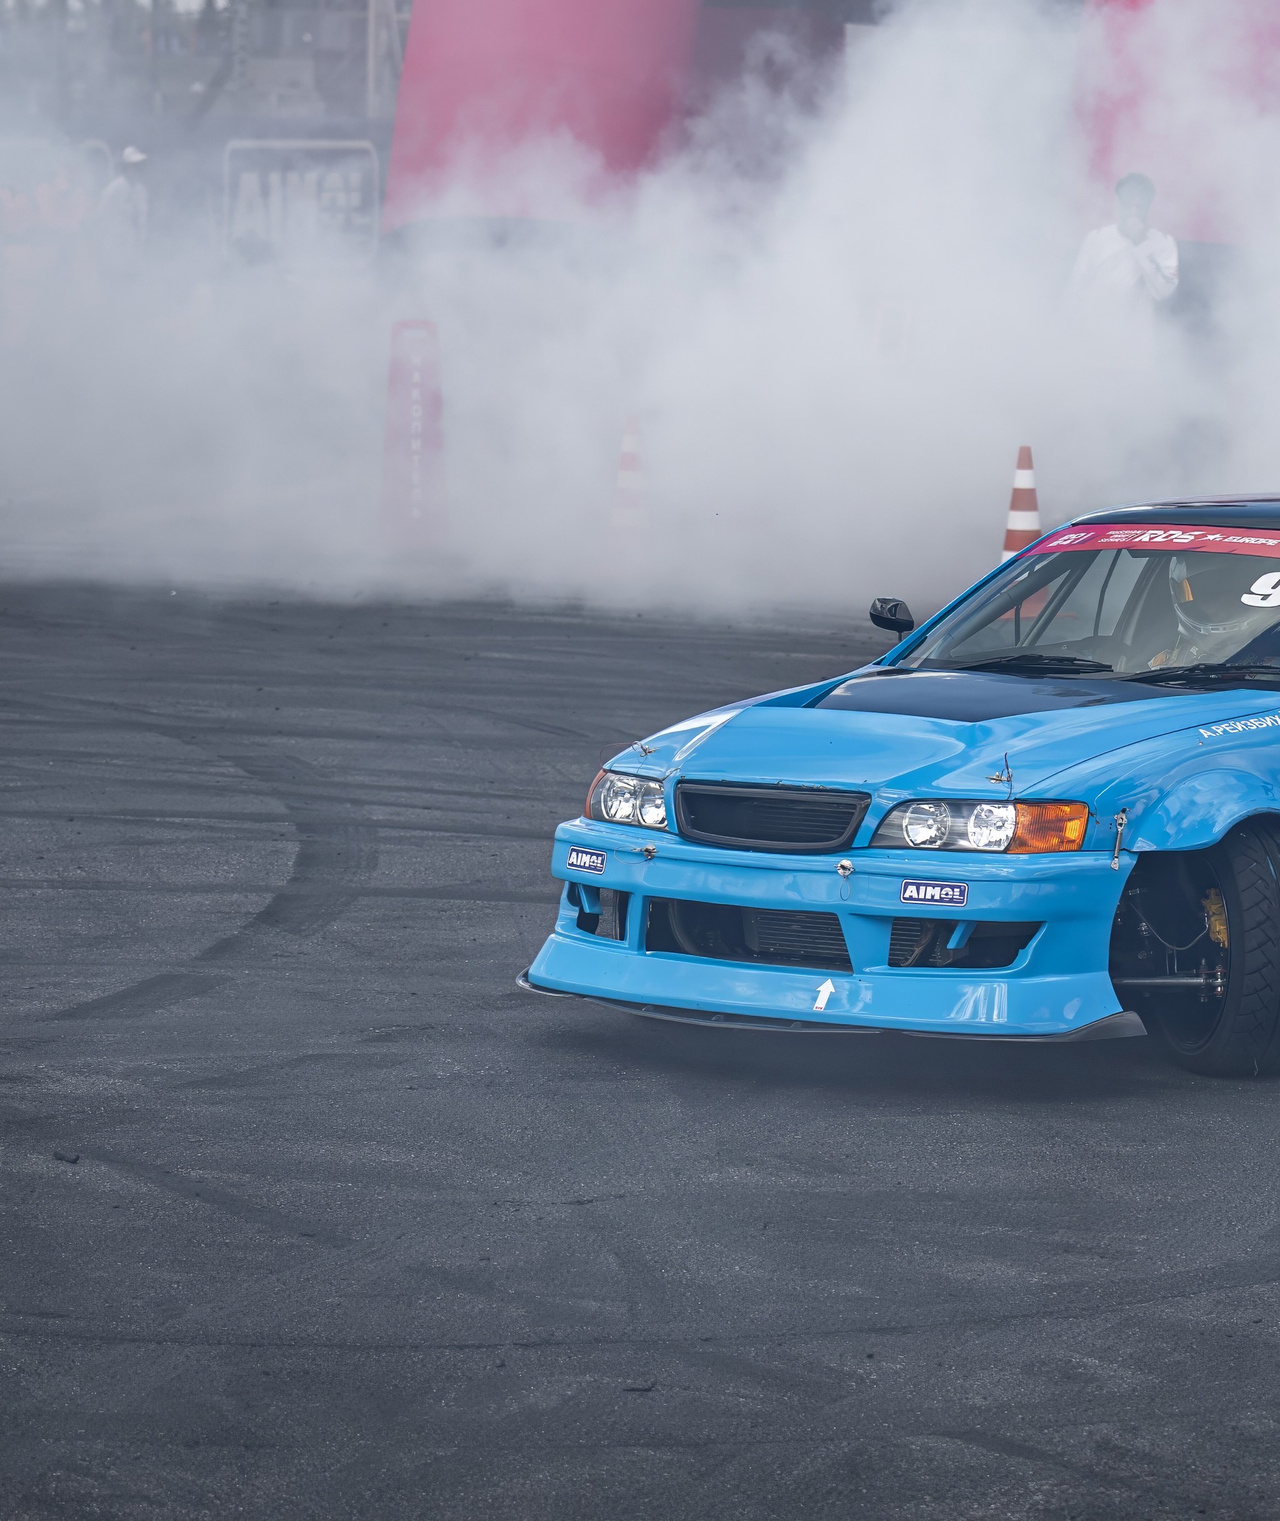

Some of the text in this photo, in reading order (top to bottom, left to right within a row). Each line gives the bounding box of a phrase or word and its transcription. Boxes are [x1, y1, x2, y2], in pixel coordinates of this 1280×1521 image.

[1132, 529, 1207, 543] RDS
[568, 851, 604, 870] AIMOL
[903, 884, 964, 902] AIMOL
